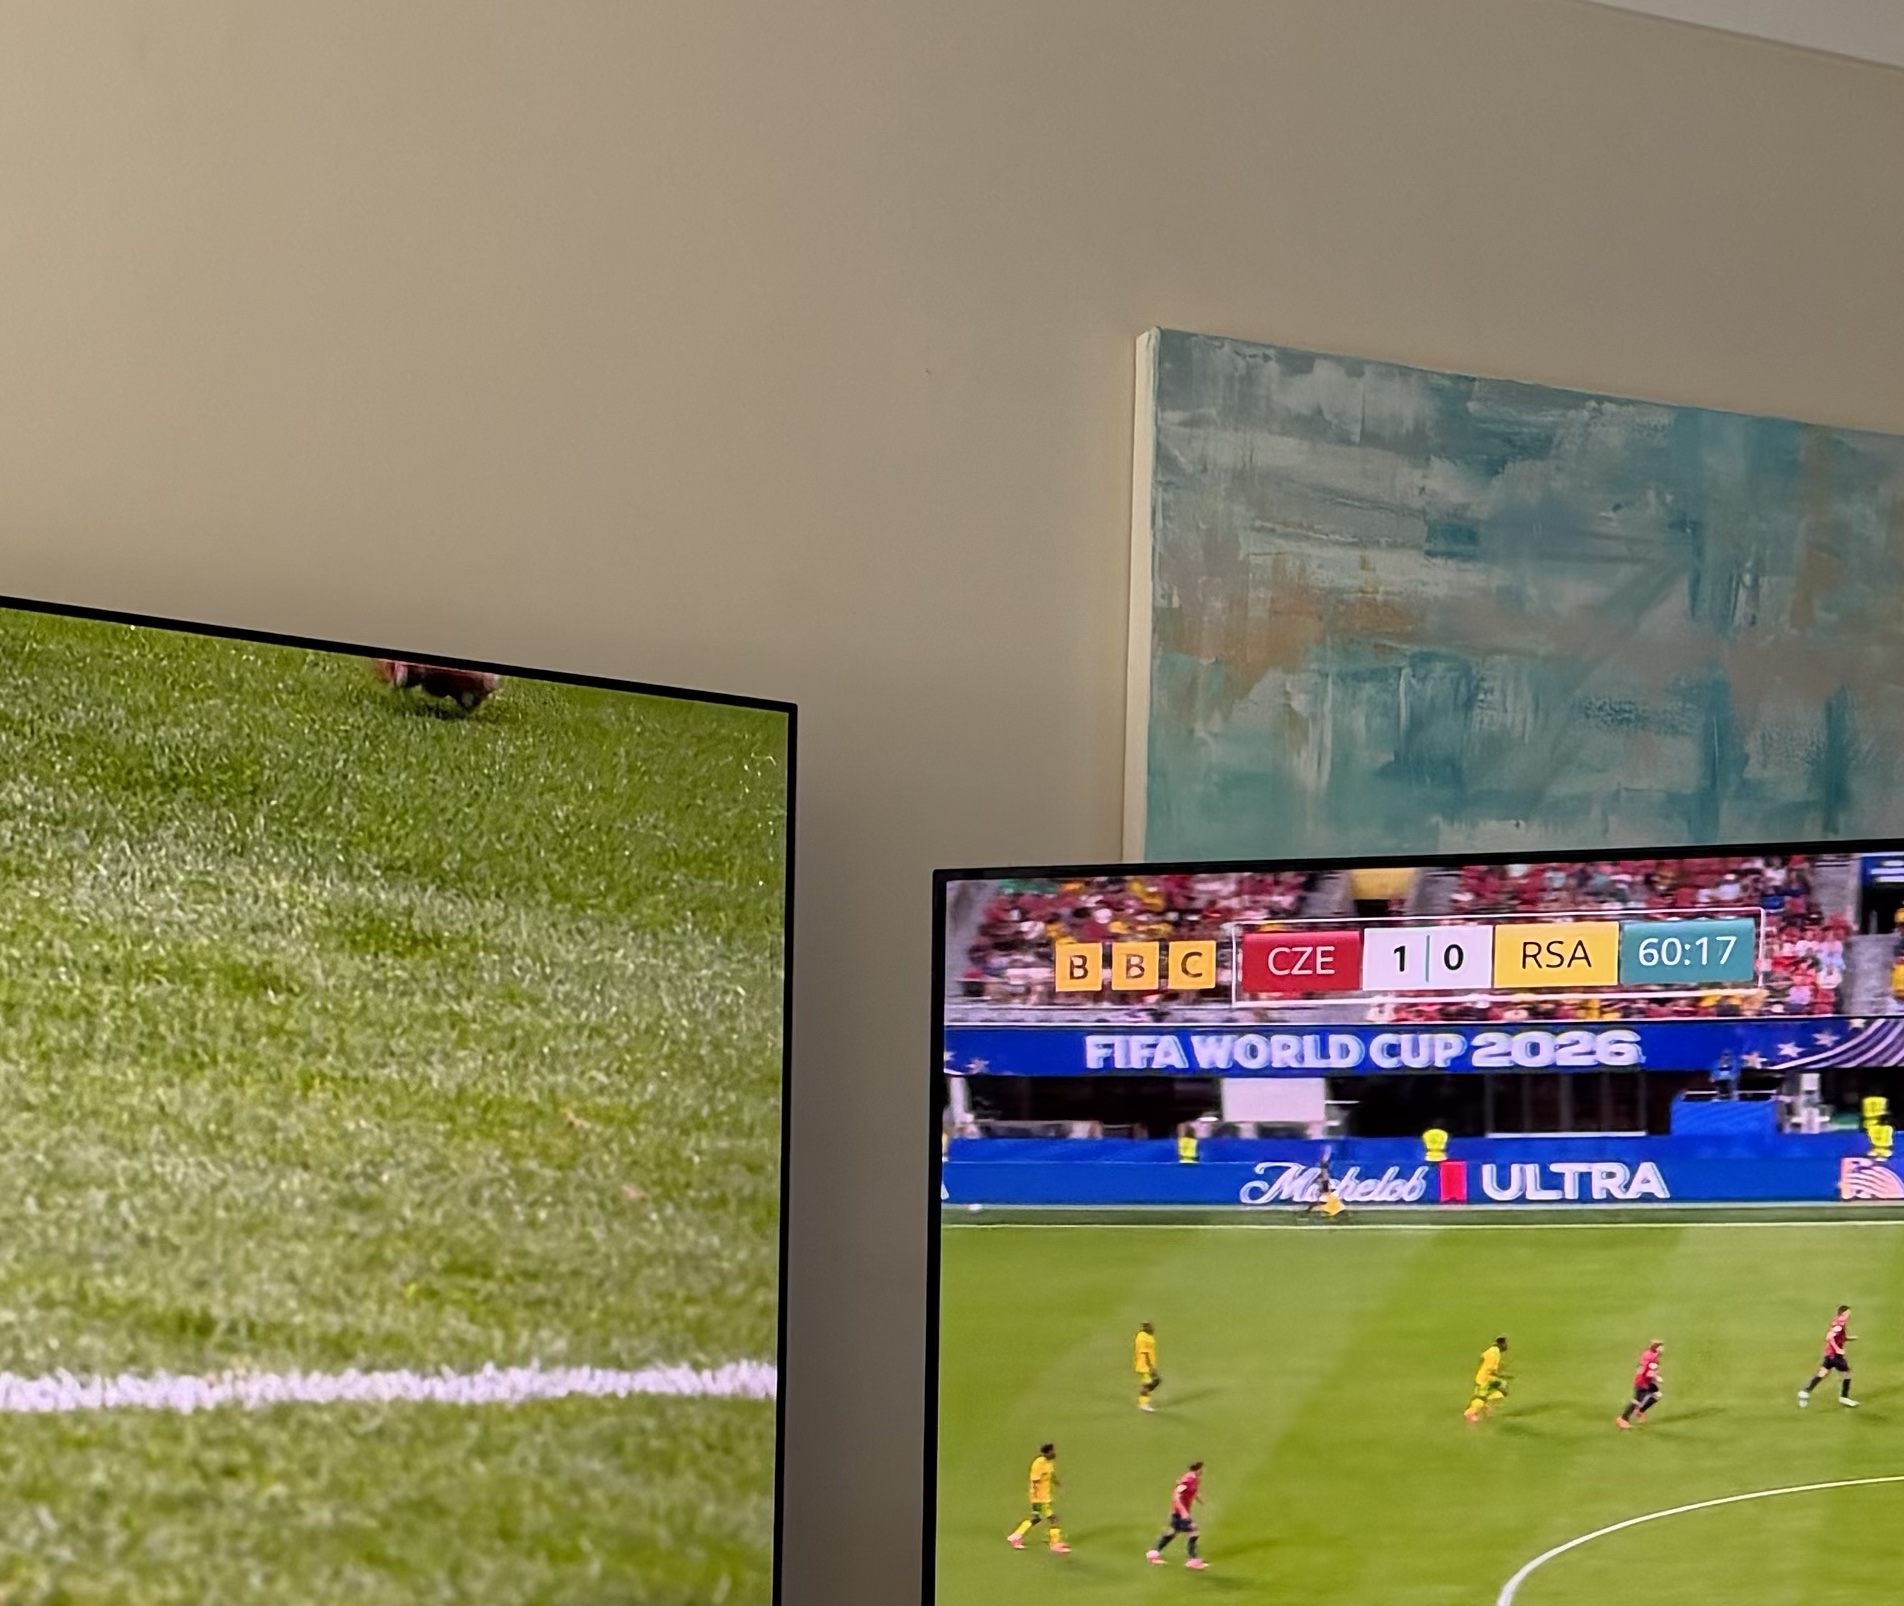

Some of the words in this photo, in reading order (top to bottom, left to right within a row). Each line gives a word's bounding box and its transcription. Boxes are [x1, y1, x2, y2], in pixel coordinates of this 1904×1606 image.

[1267, 945, 1336, 976] CZE
[1393, 945, 1405, 972] 1
[1443, 943, 1464, 970] 0
[1521, 939, 1592, 969] RSA
[1638, 936, 1737, 967] 60:17
[1085, 1034, 1189, 1070] FIFA
[1191, 1033, 1365, 1069] WORLD
[1369, 1032, 1467, 1069] CUP
[1470, 1029, 1643, 1067] 2026
[1482, 1161, 1672, 1200] ULTRA
